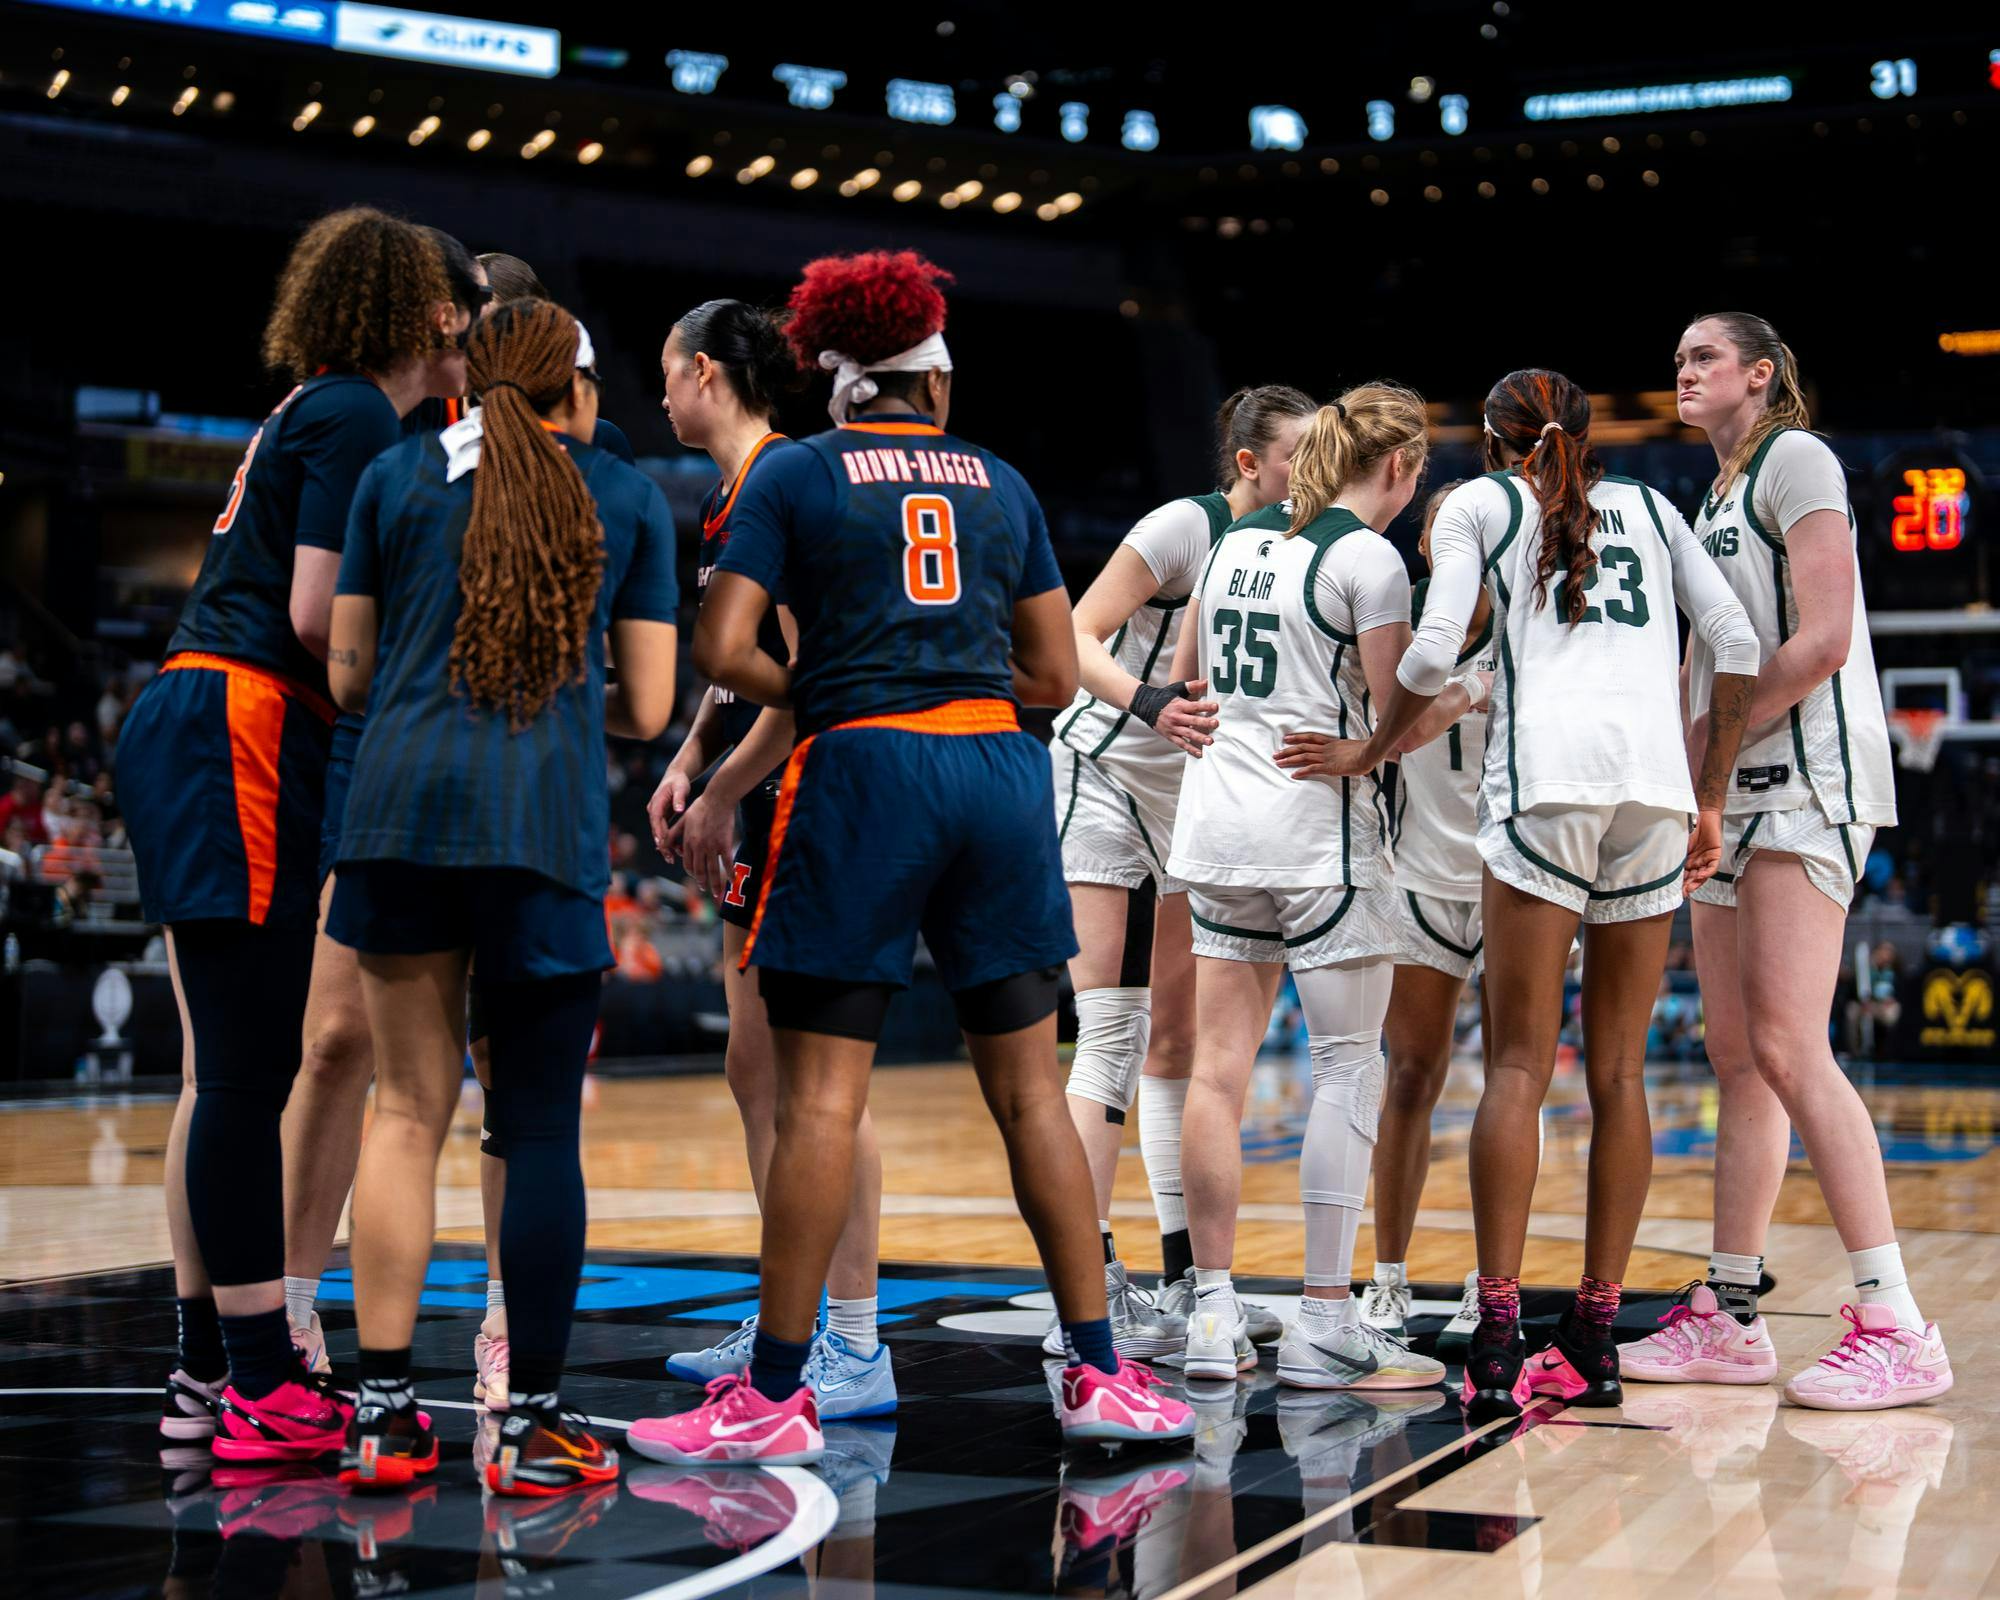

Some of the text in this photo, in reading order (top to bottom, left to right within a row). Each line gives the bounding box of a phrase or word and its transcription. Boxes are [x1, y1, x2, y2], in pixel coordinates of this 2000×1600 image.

[1870, 58, 1917, 99] 31
[902, 493, 962, 606] 8
[1891, 495, 1962, 551] 20
[1228, 568, 1276, 600] BLAIR
[1551, 544, 1650, 628] 23
[1212, 608, 1280, 698] 35
[1446, 722, 1463, 771] 1
